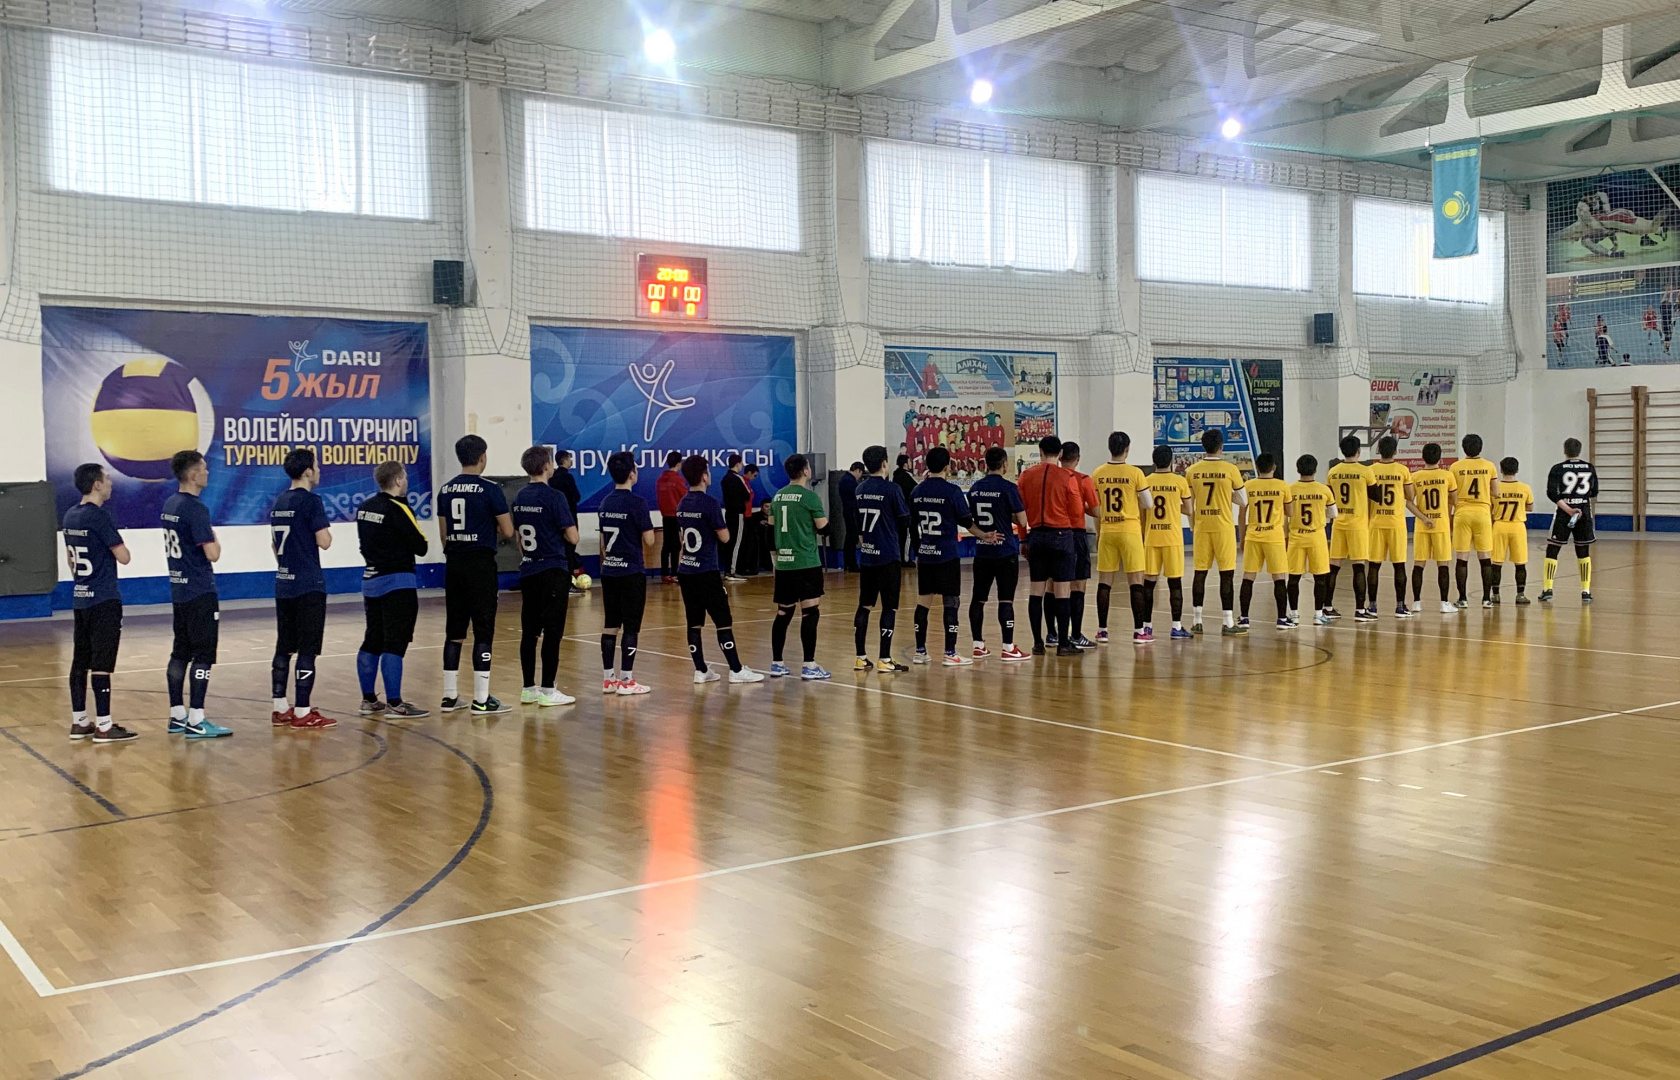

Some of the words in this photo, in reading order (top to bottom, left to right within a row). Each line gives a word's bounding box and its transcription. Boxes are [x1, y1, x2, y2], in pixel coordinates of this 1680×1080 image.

[657, 267, 689, 282] 20:00
[647, 283, 666, 300] 00
[684, 286, 701, 302] 00
[321, 349, 381, 367] DARU
[261, 358, 292, 400] 5
[292, 372, 380, 399] ЖЫЛ
[1370, 380, 1400, 392] ешек
[223, 412, 333, 442] ВОЛЕЙБОЛ
[321, 440, 420, 465] ВОЛЕЙБОЛУ
[1152, 485, 1177, 493] ALIKHAN
[1202, 481, 1215, 506] 7
[1340, 482, 1350, 505] 9
[1467, 477, 1480, 499] 4
[1562, 471, 1593, 495] 93
[1103, 487, 1123, 513] 13
[1153, 495, 1166, 520] 8
[1254, 499, 1274, 524] 17
[1422, 488, 1440, 511] 10
[1498, 501, 1519, 522] 77
[451, 498, 466, 530] 9
[781, 505, 788, 533] 1
[858, 508, 881, 533] 77
[918, 510, 942, 536] 22
[976, 502, 994, 526] 5
[1300, 503, 1313, 527] 5
[163, 528, 183, 559] 88
[519, 524, 538, 552] 8
[602, 526, 620, 553] 7
[881, 628, 894, 638] 77
[1006, 620, 1015, 629] 5
[481, 652, 492, 662] 9
[627, 647, 637, 656] 7
[296, 669, 314, 680] 17
